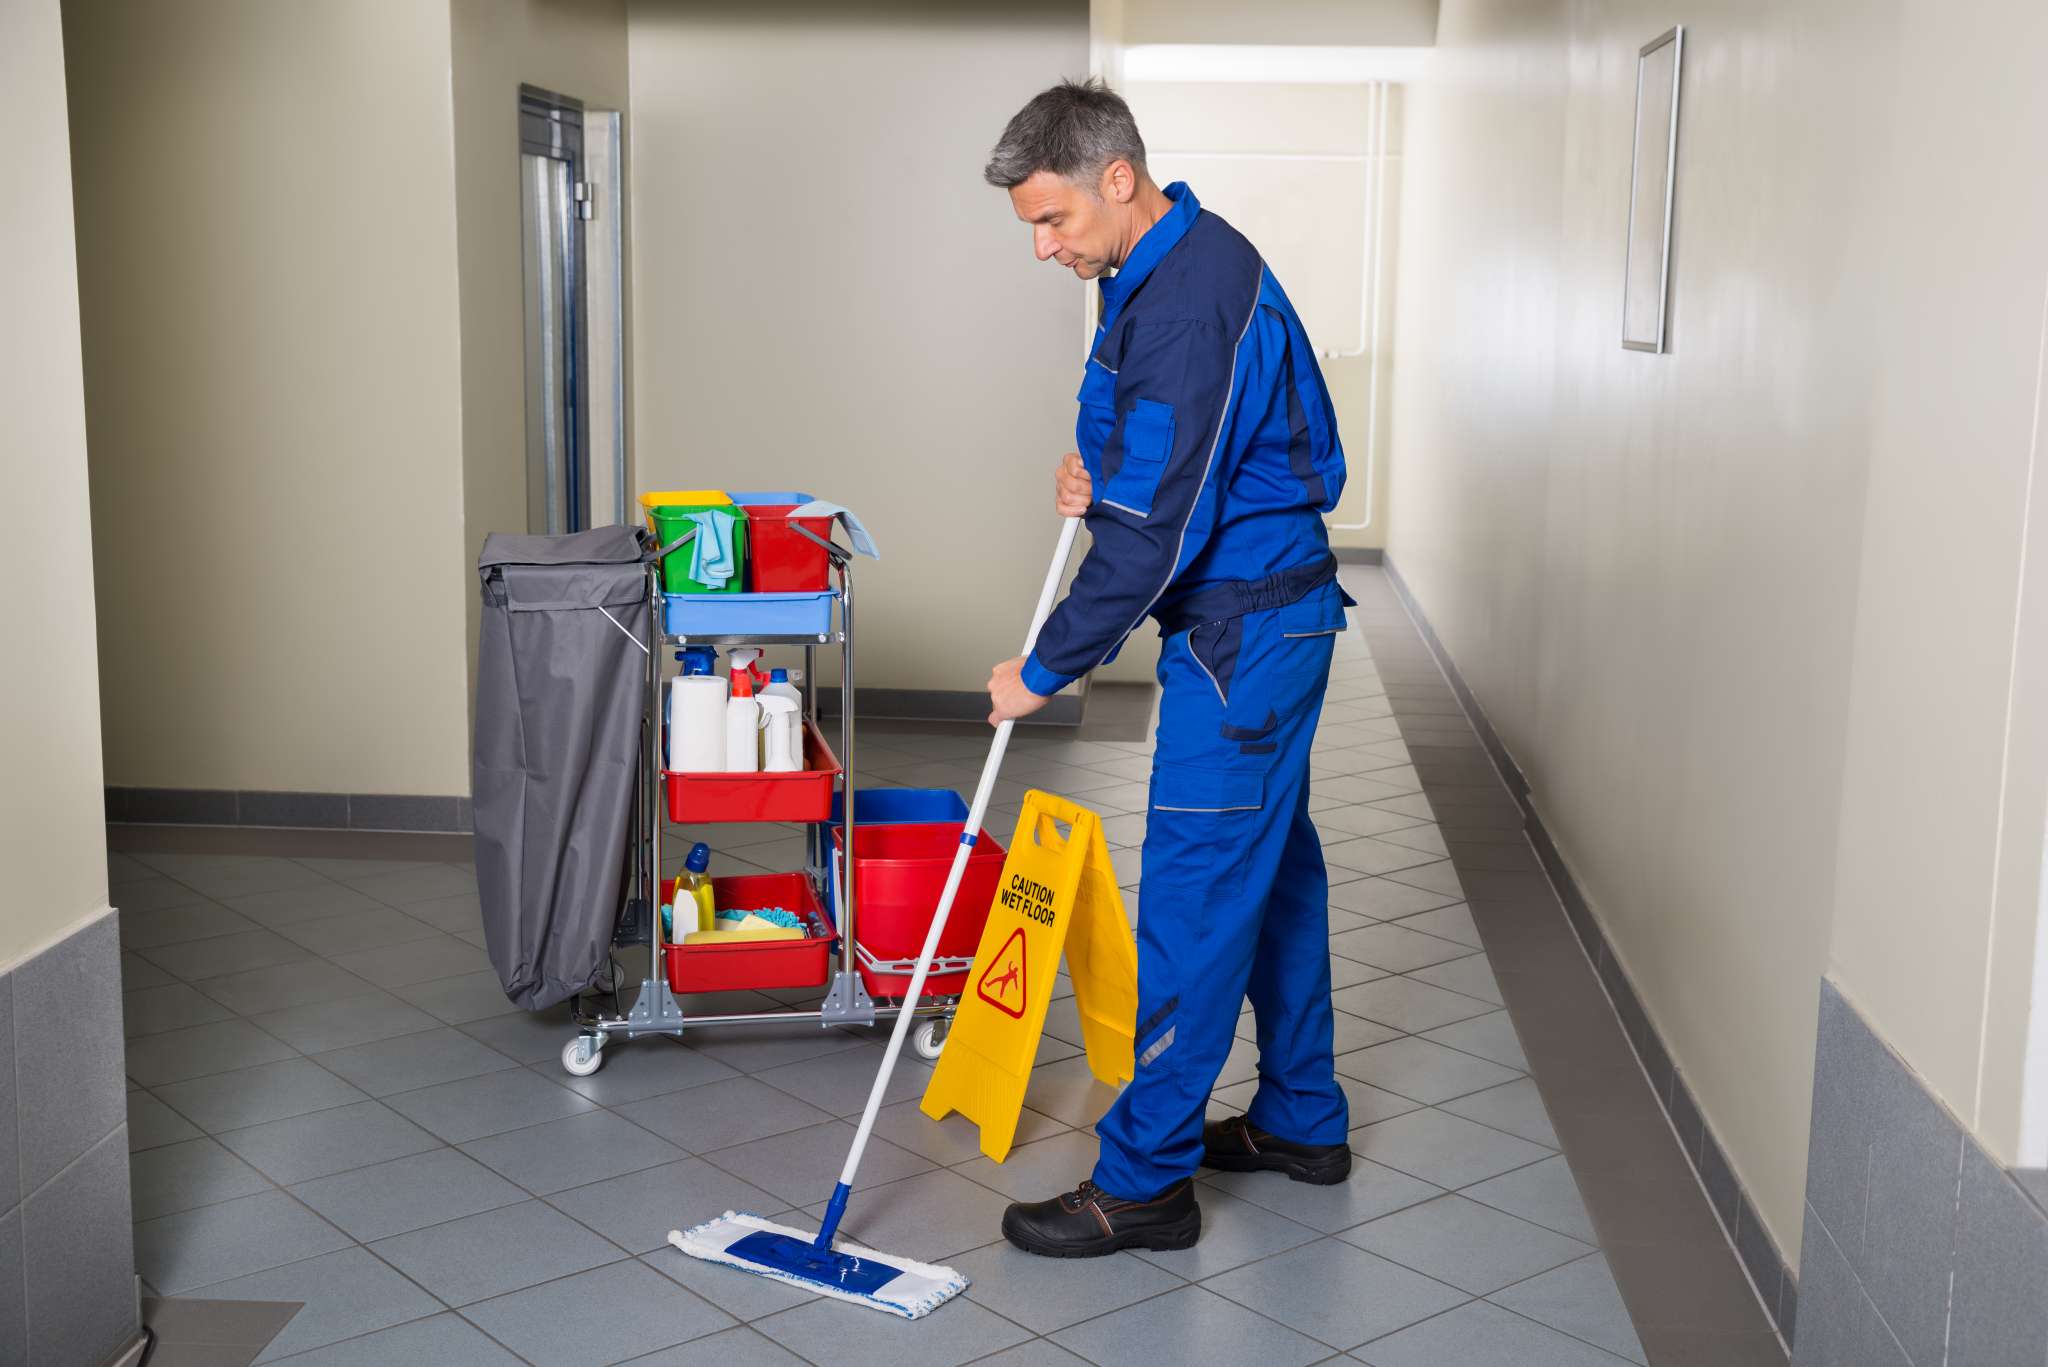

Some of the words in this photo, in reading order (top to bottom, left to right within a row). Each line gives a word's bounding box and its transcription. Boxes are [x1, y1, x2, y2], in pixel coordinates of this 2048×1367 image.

[1001, 888, 1023, 911] WET
[1022, 899, 1055, 927] FLOOR
[1011, 874, 1055, 906] CAUTION
